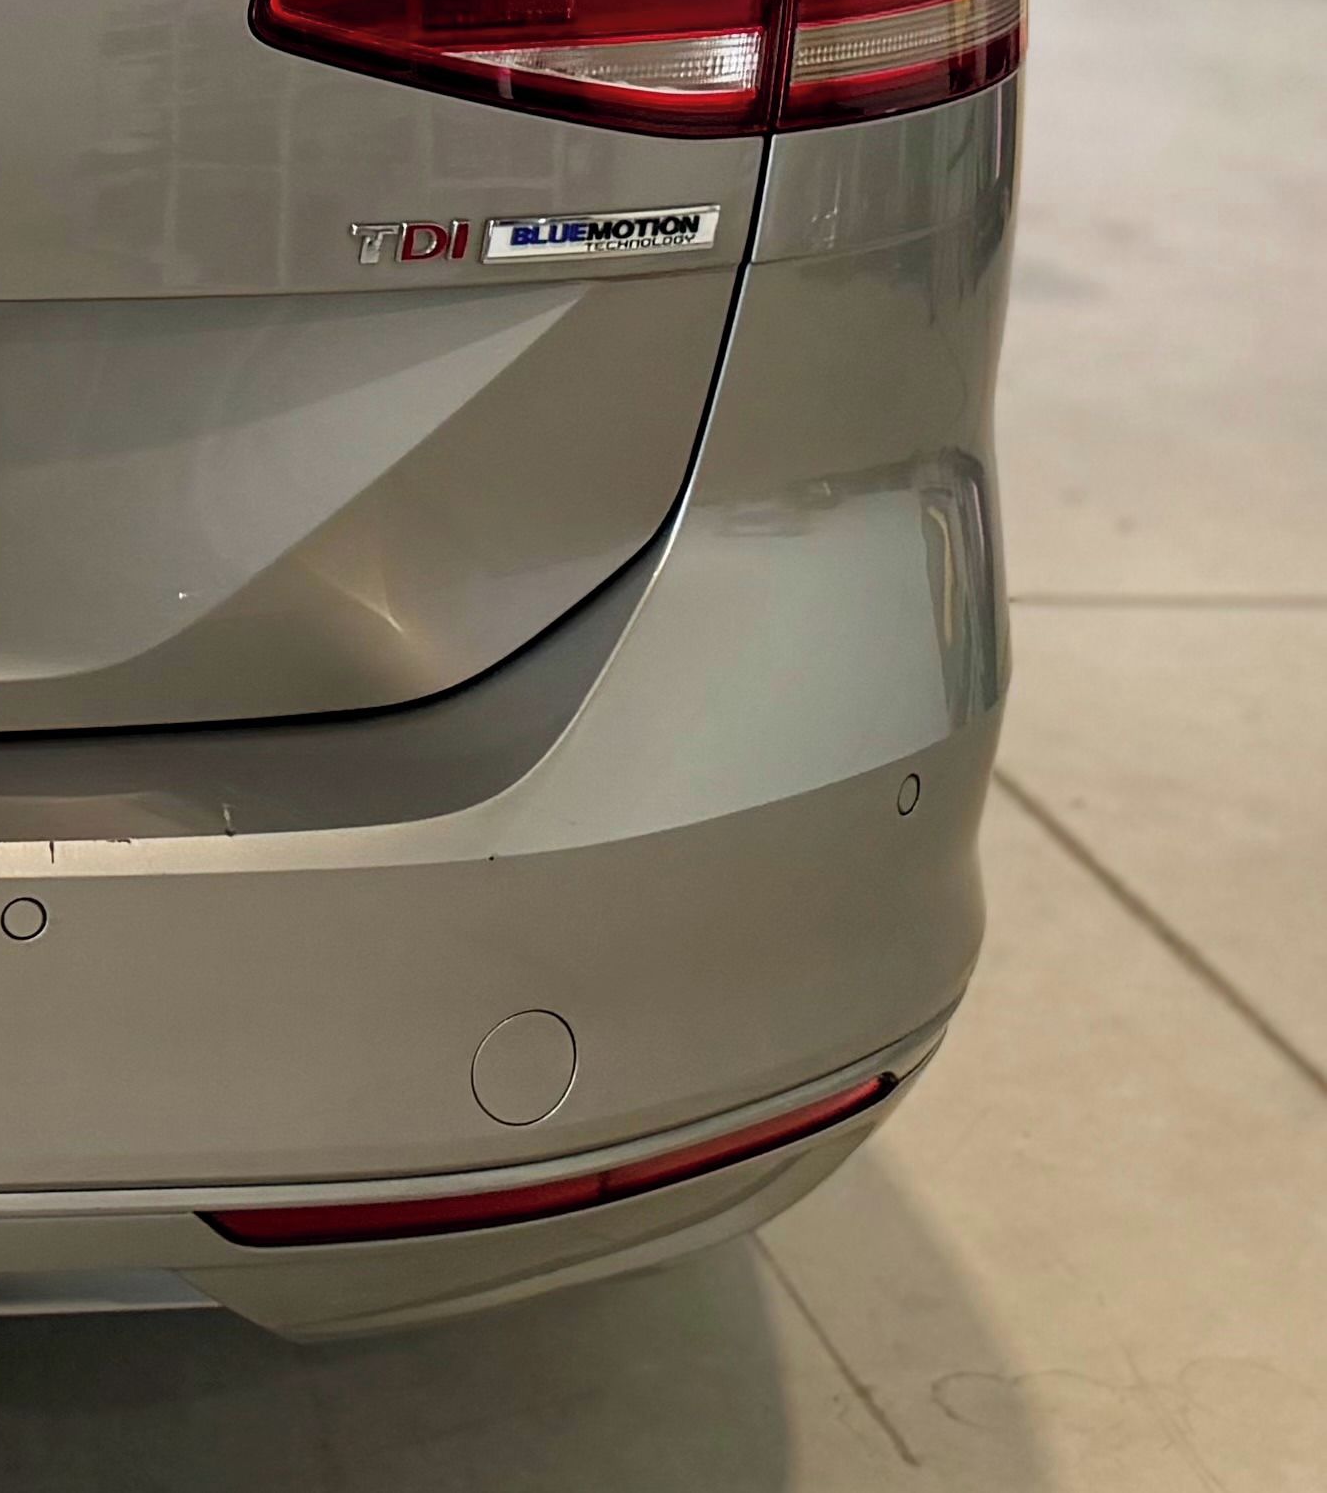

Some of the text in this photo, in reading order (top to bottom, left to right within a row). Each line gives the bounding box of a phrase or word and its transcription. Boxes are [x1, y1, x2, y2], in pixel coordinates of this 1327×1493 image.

[349, 215, 700, 265] TDI BLUEMOTION
[584, 234, 696, 252] TECHNOLOGY
